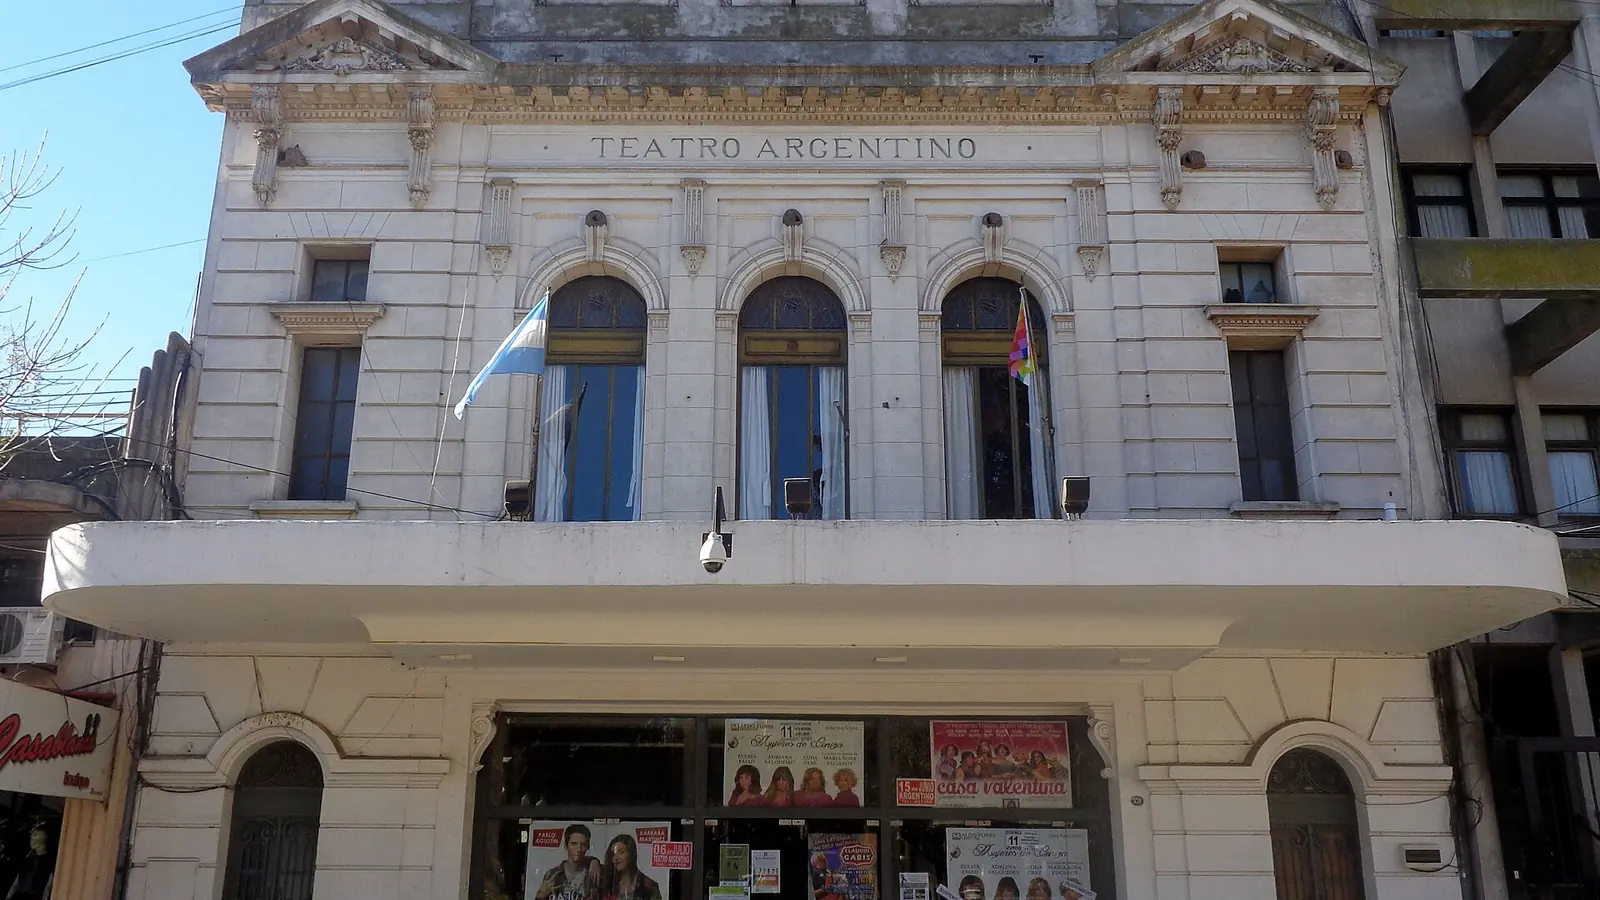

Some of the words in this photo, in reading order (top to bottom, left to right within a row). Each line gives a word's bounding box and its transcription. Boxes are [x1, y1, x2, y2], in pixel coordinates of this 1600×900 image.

[590, 137, 740, 159] TEATRO
[756, 137, 976, 160] ARGENTINO
[780, 725, 792, 738] 11
[899, 781, 911, 793] 15
[937, 781, 978, 796] casa
[983, 779, 1067, 797] valentina
[899, 792, 935, 801] ARGENTINO
[1008, 835, 1019, 846] 11
[653, 844, 667, 855] 06
[673, 844, 691, 856] JULIO
